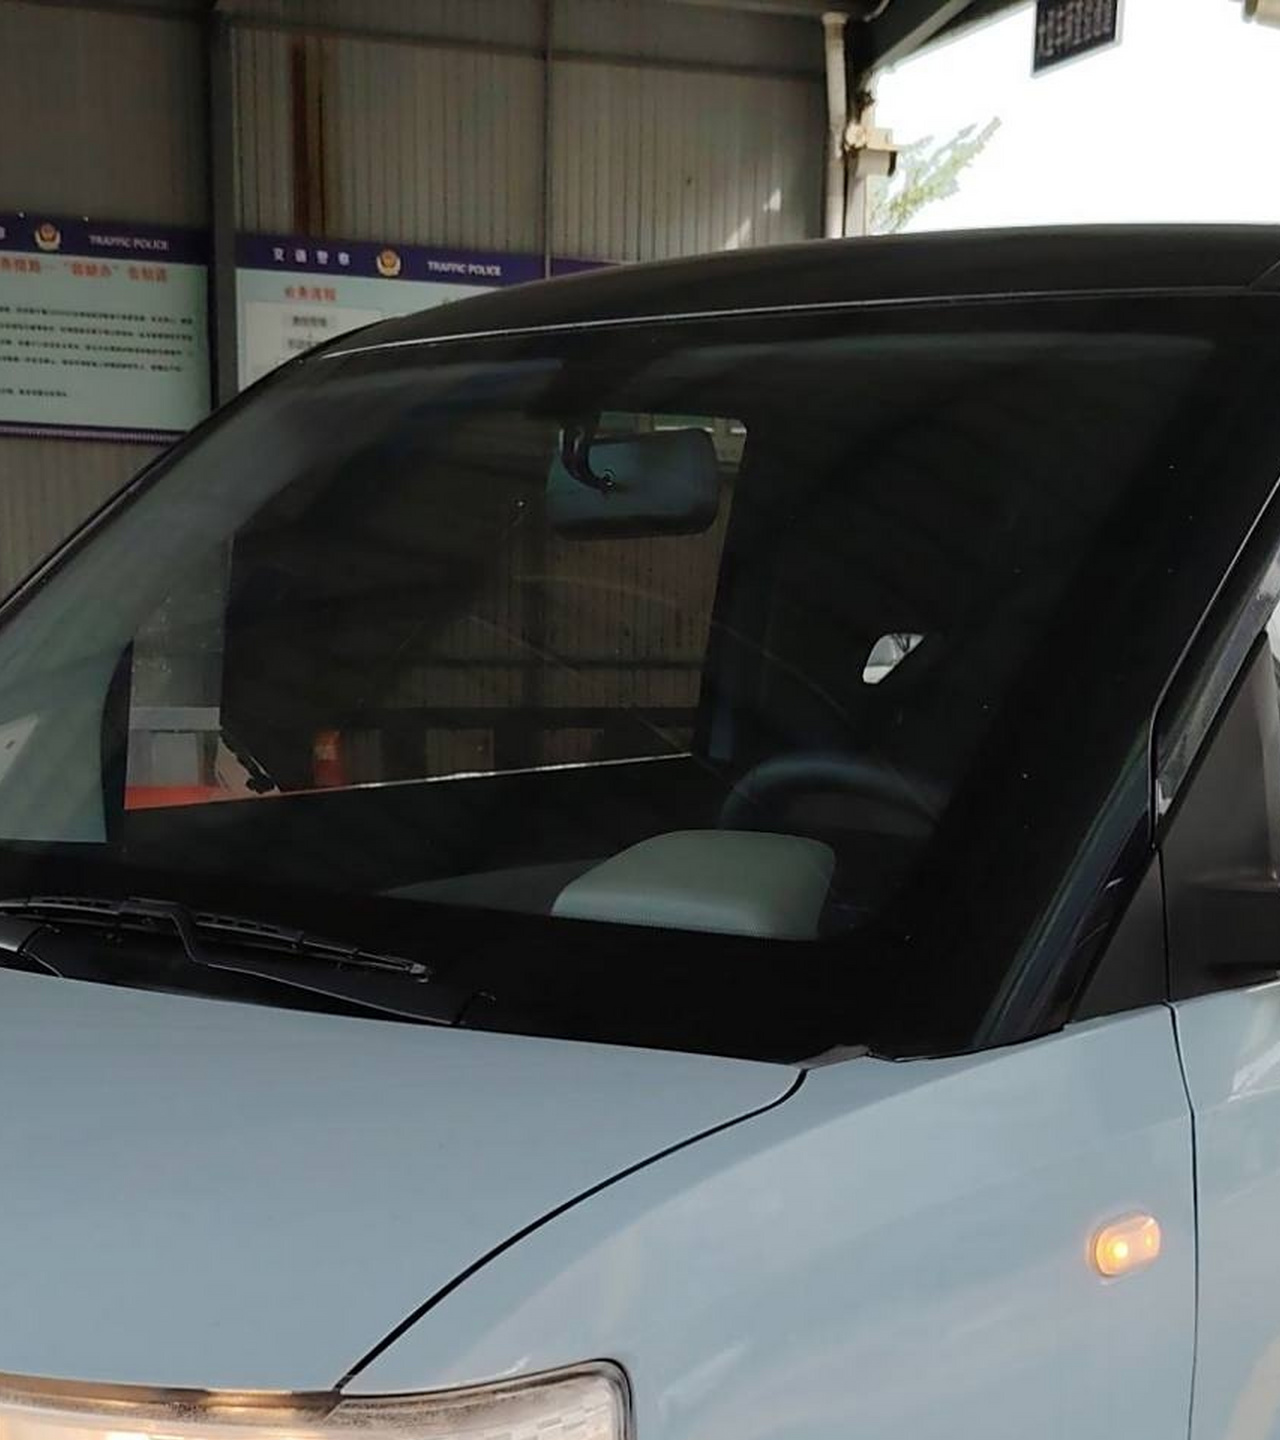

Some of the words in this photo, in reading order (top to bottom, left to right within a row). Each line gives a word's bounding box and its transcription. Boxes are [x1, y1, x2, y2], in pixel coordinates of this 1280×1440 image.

[89, 234, 131, 250] TRAFFIC
[132, 238, 170, 251] POLICE
[427, 260, 466, 275] TRAFFIC
[468, 263, 502, 277] POLICE
